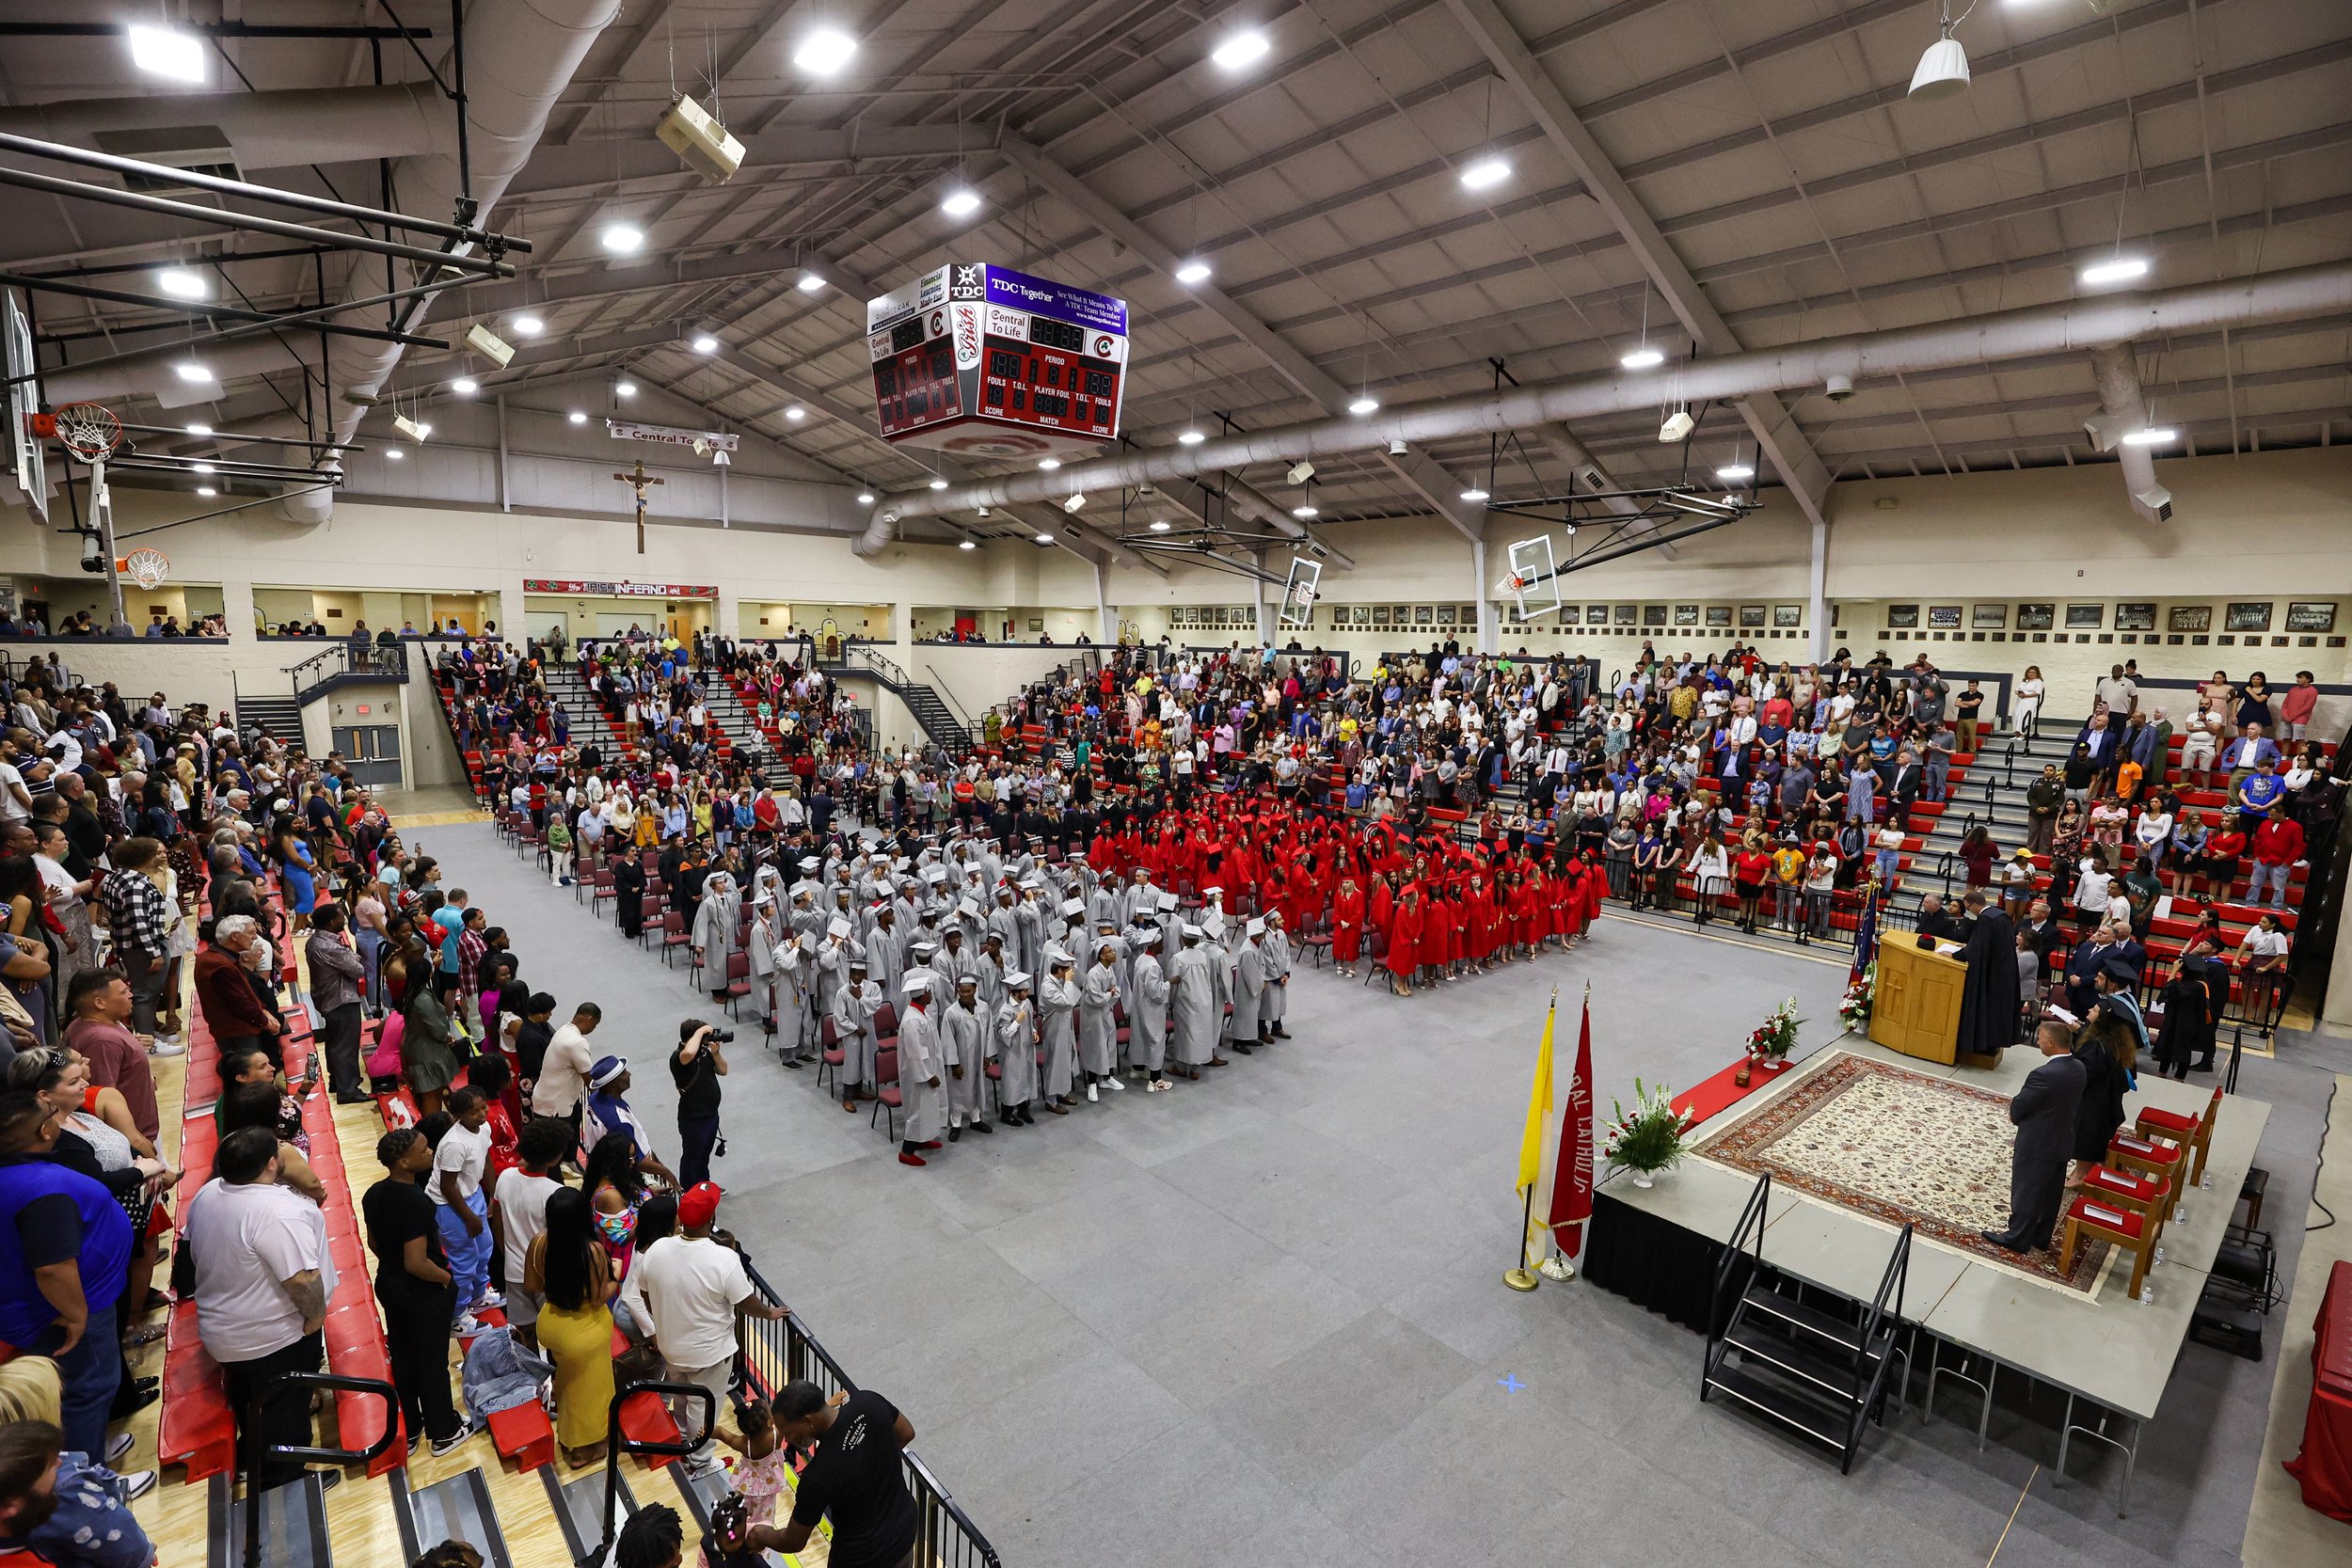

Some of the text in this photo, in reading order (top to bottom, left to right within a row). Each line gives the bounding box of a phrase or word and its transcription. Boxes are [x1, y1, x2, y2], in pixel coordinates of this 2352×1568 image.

[992, 278, 1018, 293] TDC
[951, 286, 984, 296] TDC
[1057, 290, 1067, 299] See
[1068, 293, 1082, 303] What
[1088, 299, 1104, 309] Means
[1113, 304, 1121, 313] Be
[1070, 301, 1083, 310] TDC
[1084, 305, 1099, 315] Team
[1100, 309, 1120, 321] Member
[991, 310, 1025, 326] Central
[956, 305, 978, 361] Irish
[993, 323, 1021, 338] To Life
[871, 335, 890, 349] Central
[874, 347, 889, 358] To Life
[905, 356, 917, 366] PERIOD
[1045, 355, 1065, 365] PERIOD
[943, 376, 954, 386] FOULS
[987, 376, 1007, 387] FOULS
[1012, 381, 1027, 390] T.O.L.
[905, 388, 917, 398] PLAYER
[1035, 386, 1070, 399] PLAYER FOUL
[881, 397, 891, 405] FOULS
[1075, 393, 1089, 403] T.O.L.
[1095, 398, 1112, 407] FOULS
[946, 406, 958, 416] SCORE
[984, 406, 1003, 416] SCORE
[914, 416, 926, 425] MATCH
[1040, 416, 1059, 425] MATCH
[1092, 425, 1108, 434] SCORE
[632, 431, 676, 442] Central
[615, 583, 666, 594] INFERNO
